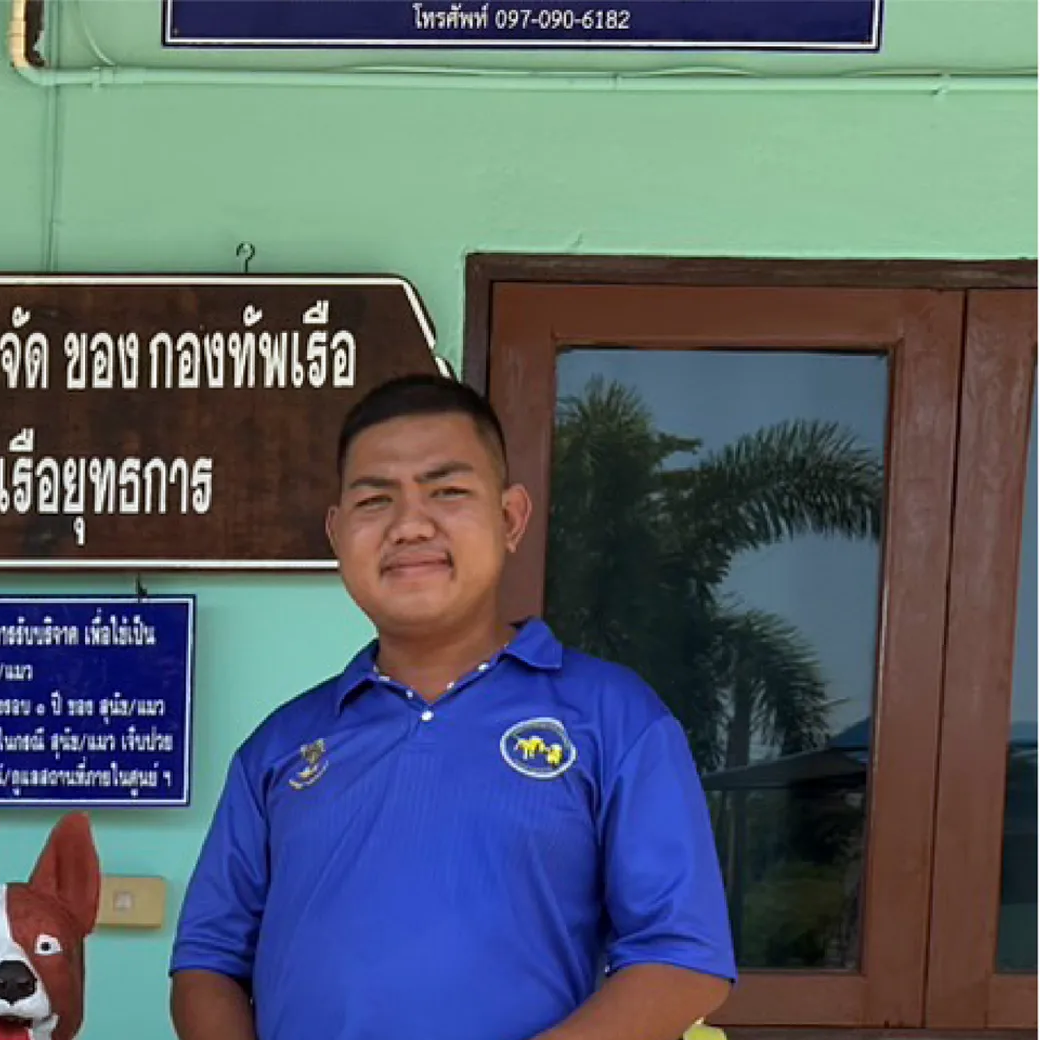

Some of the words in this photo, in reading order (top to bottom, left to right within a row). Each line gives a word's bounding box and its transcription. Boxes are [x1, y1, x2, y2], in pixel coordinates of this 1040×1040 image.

[412, 2, 489, 29] โทรศัพท์
[495, 9, 631, 30] 097-090-6182
[64, 332, 140, 389] ของ
[149, 300, 357, 389] กองทัพเรือ
